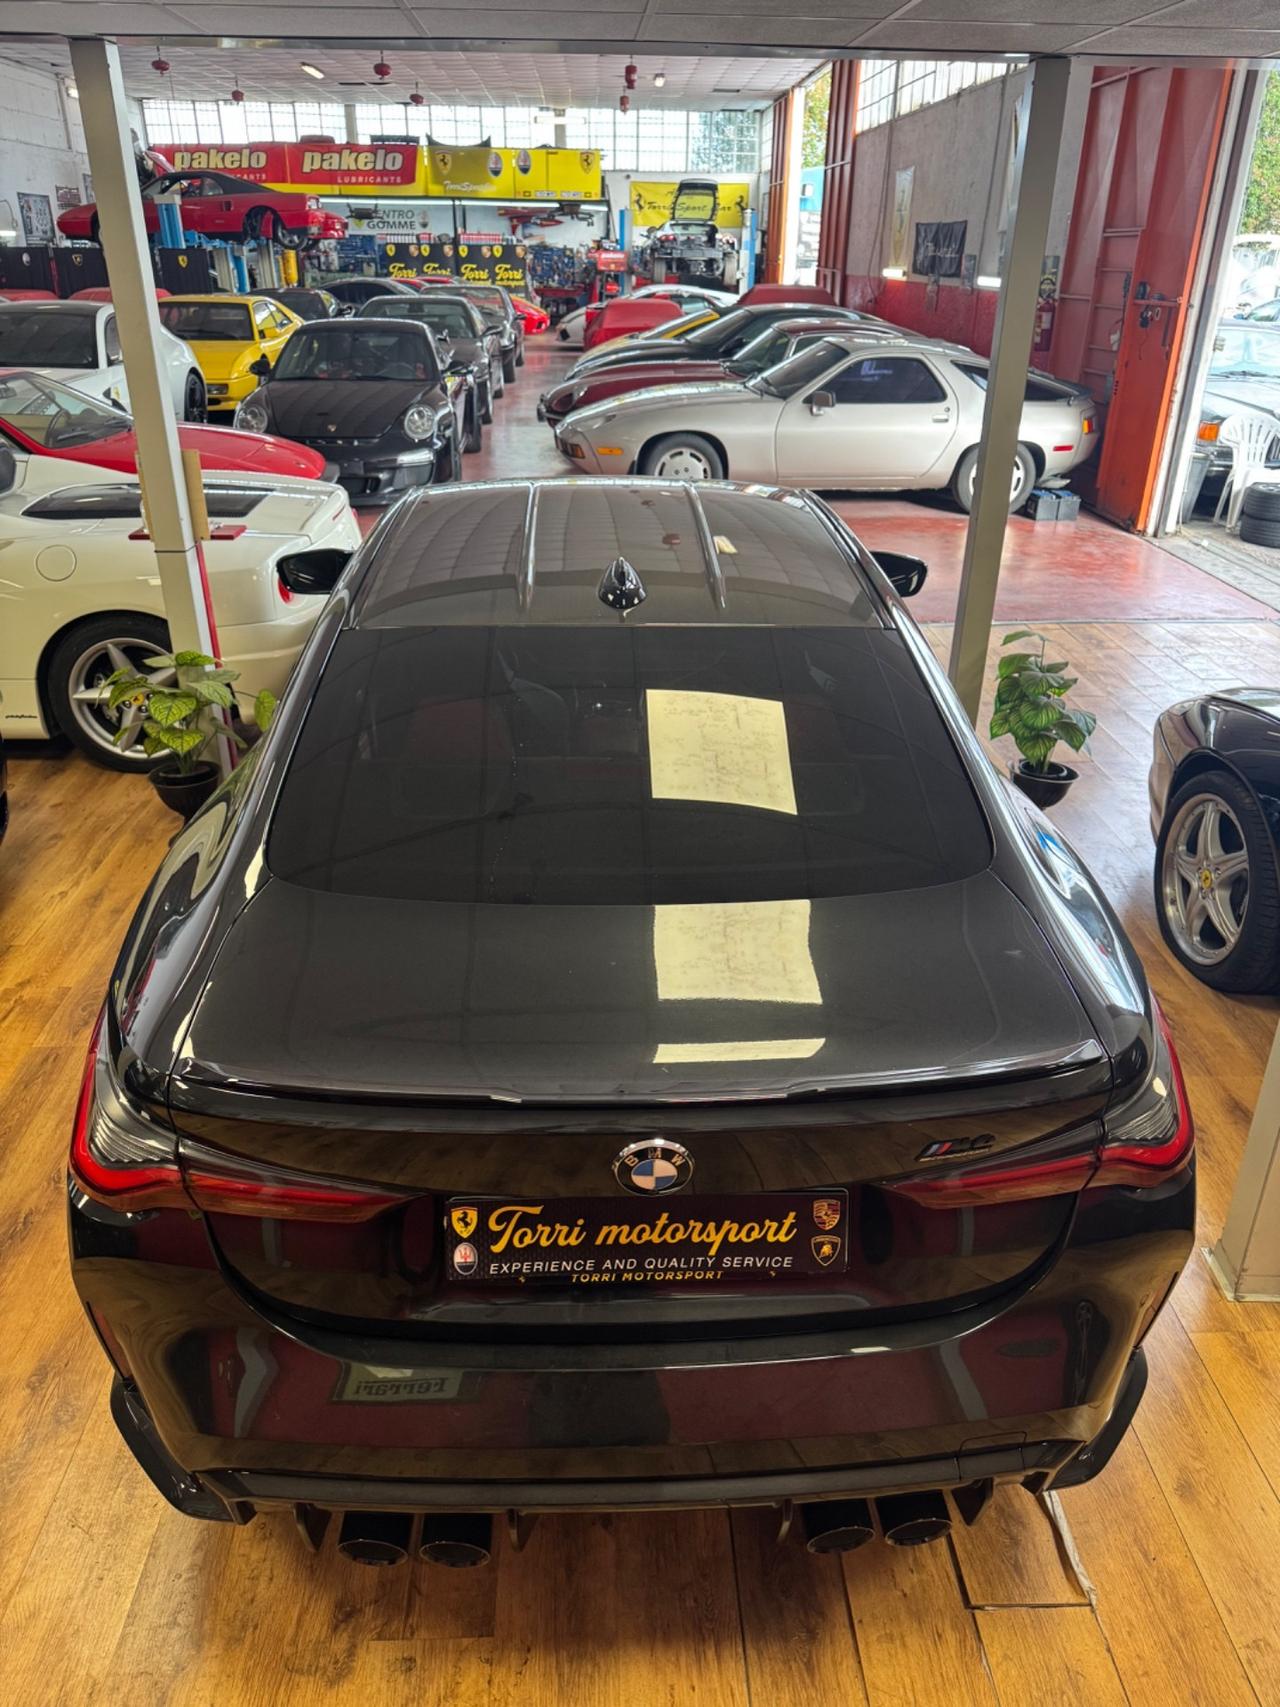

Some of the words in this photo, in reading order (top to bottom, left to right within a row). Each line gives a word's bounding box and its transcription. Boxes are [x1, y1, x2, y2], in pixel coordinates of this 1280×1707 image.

[174, 149, 267, 171] pakelo
[302, 149, 403, 173] pakelo
[376, 209, 415, 220] ENTRO
[367, 220, 416, 230] GOMME
[389, 263, 417, 278] Torri
[461, 264, 489, 279] Torri
[495, 264, 523, 280] Torri
[488, 1205, 586, 1253] Torri
[595, 1211, 798, 1256] motorsport
[489, 1259, 595, 1275] EXPERIENCE
[602, 1258, 639, 1271] AND
[644, 1256, 715, 1270] QUALITY
[722, 1255, 793, 1269] SERVICE
[571, 1272, 616, 1283] TORRI
[622, 1270, 725, 1283] MOTORSPORT
